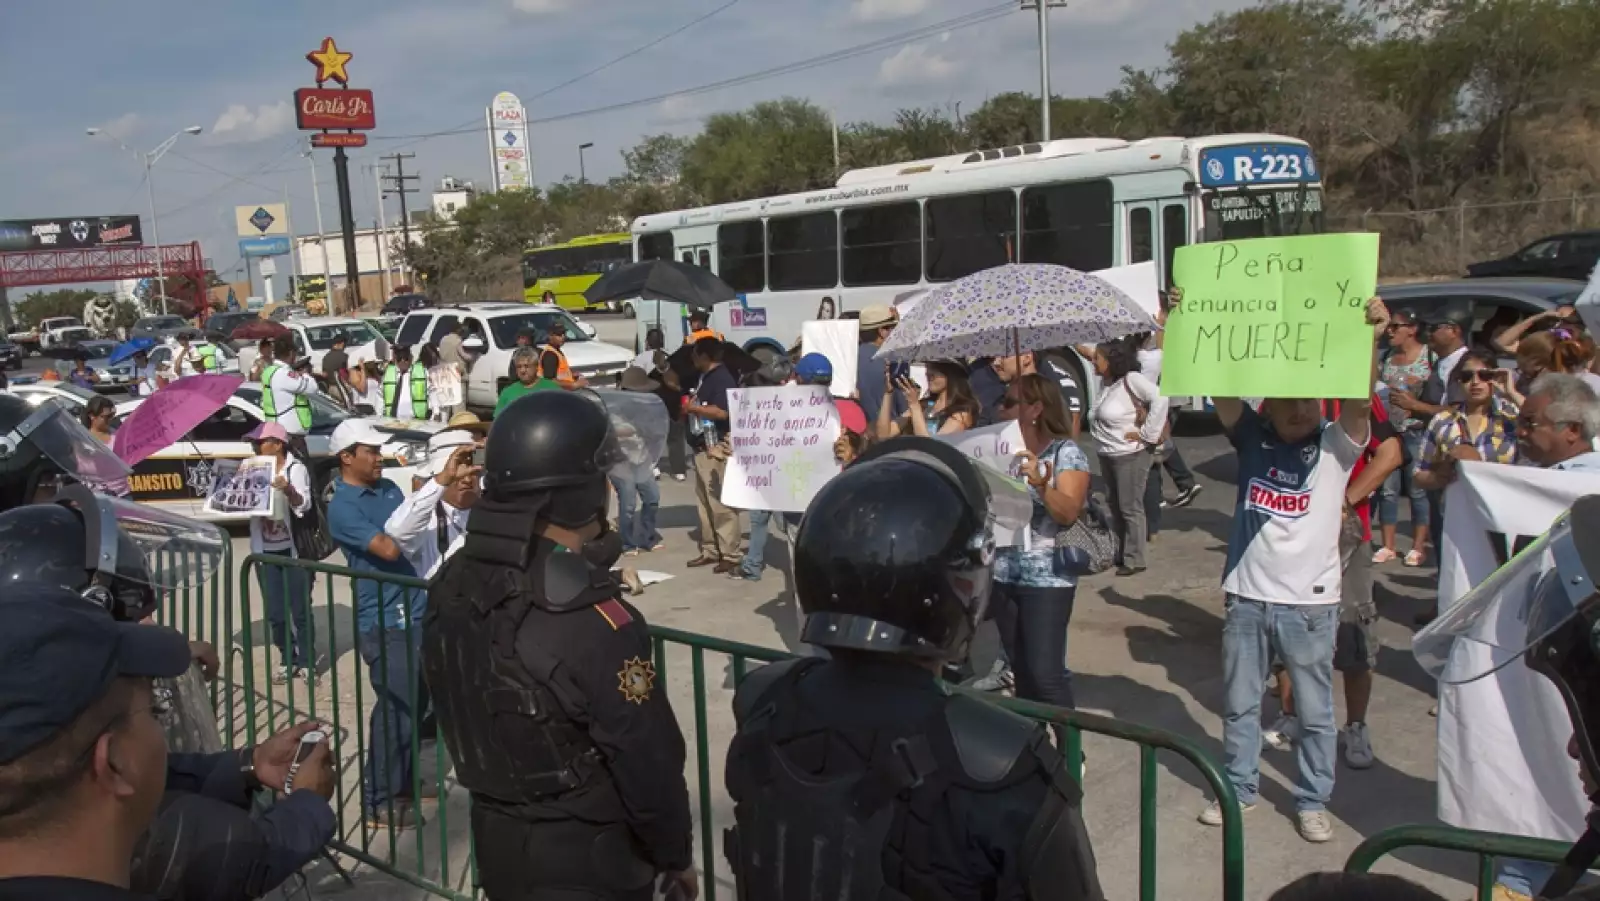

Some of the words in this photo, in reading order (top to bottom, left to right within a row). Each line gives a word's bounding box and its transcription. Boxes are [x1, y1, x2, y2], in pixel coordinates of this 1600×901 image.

[303, 96, 346, 115] Carl's
[347, 97, 372, 117] Jr.
[496, 110, 521, 120] PLAZA
[1233, 154, 1302, 181] R-223
[805, 184, 909, 204] www.suburbia.com.mx
[1304, 296, 1316, 310] o
[1336, 279, 1361, 308] Ya
[1193, 322, 1329, 369] MUERE!
[994, 439, 1010, 456] la
[128, 473, 182, 492] RANSITO
[1250, 485, 1310, 511] BIMBO
